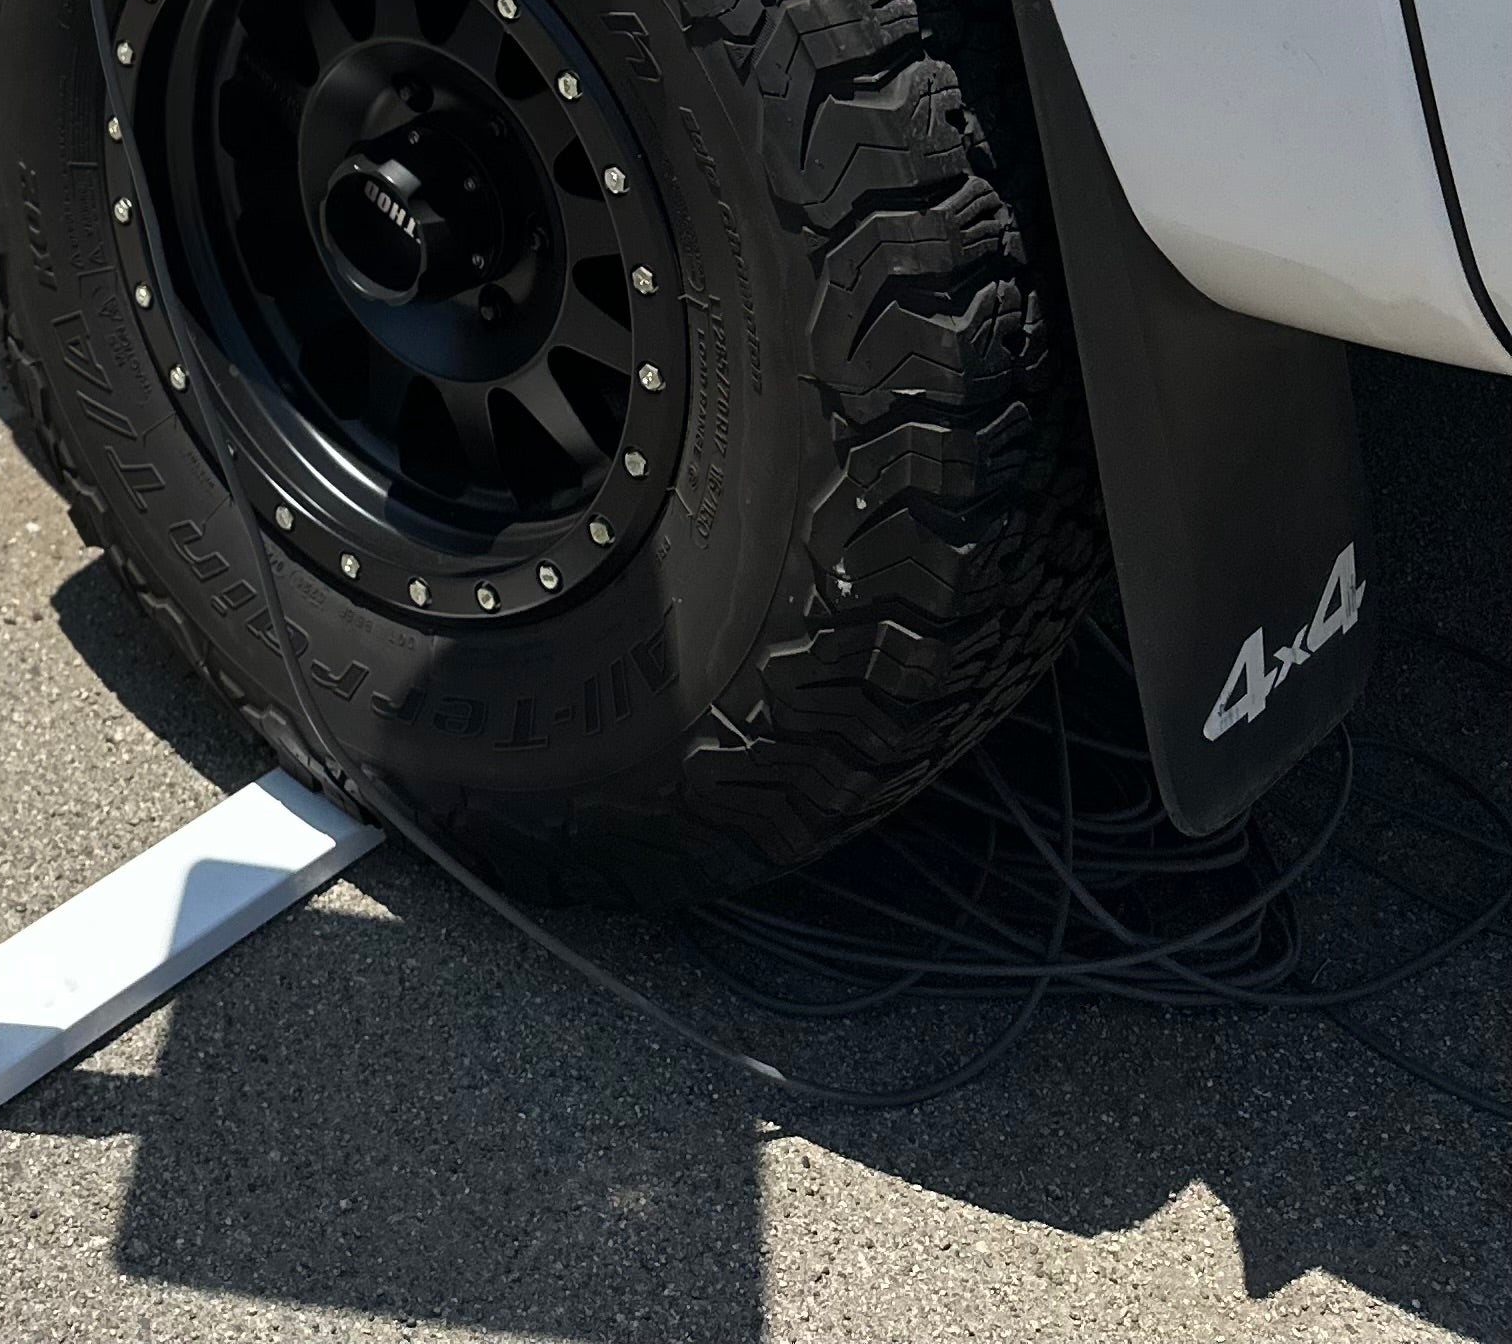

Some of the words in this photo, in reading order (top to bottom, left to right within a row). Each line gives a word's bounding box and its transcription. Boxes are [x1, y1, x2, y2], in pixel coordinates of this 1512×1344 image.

[364, 180, 421, 244] THOD
[50, 309, 166, 513] T/A
[168, 519, 679, 752] All-Terrain
[1203, 541, 1366, 742] 4x4
